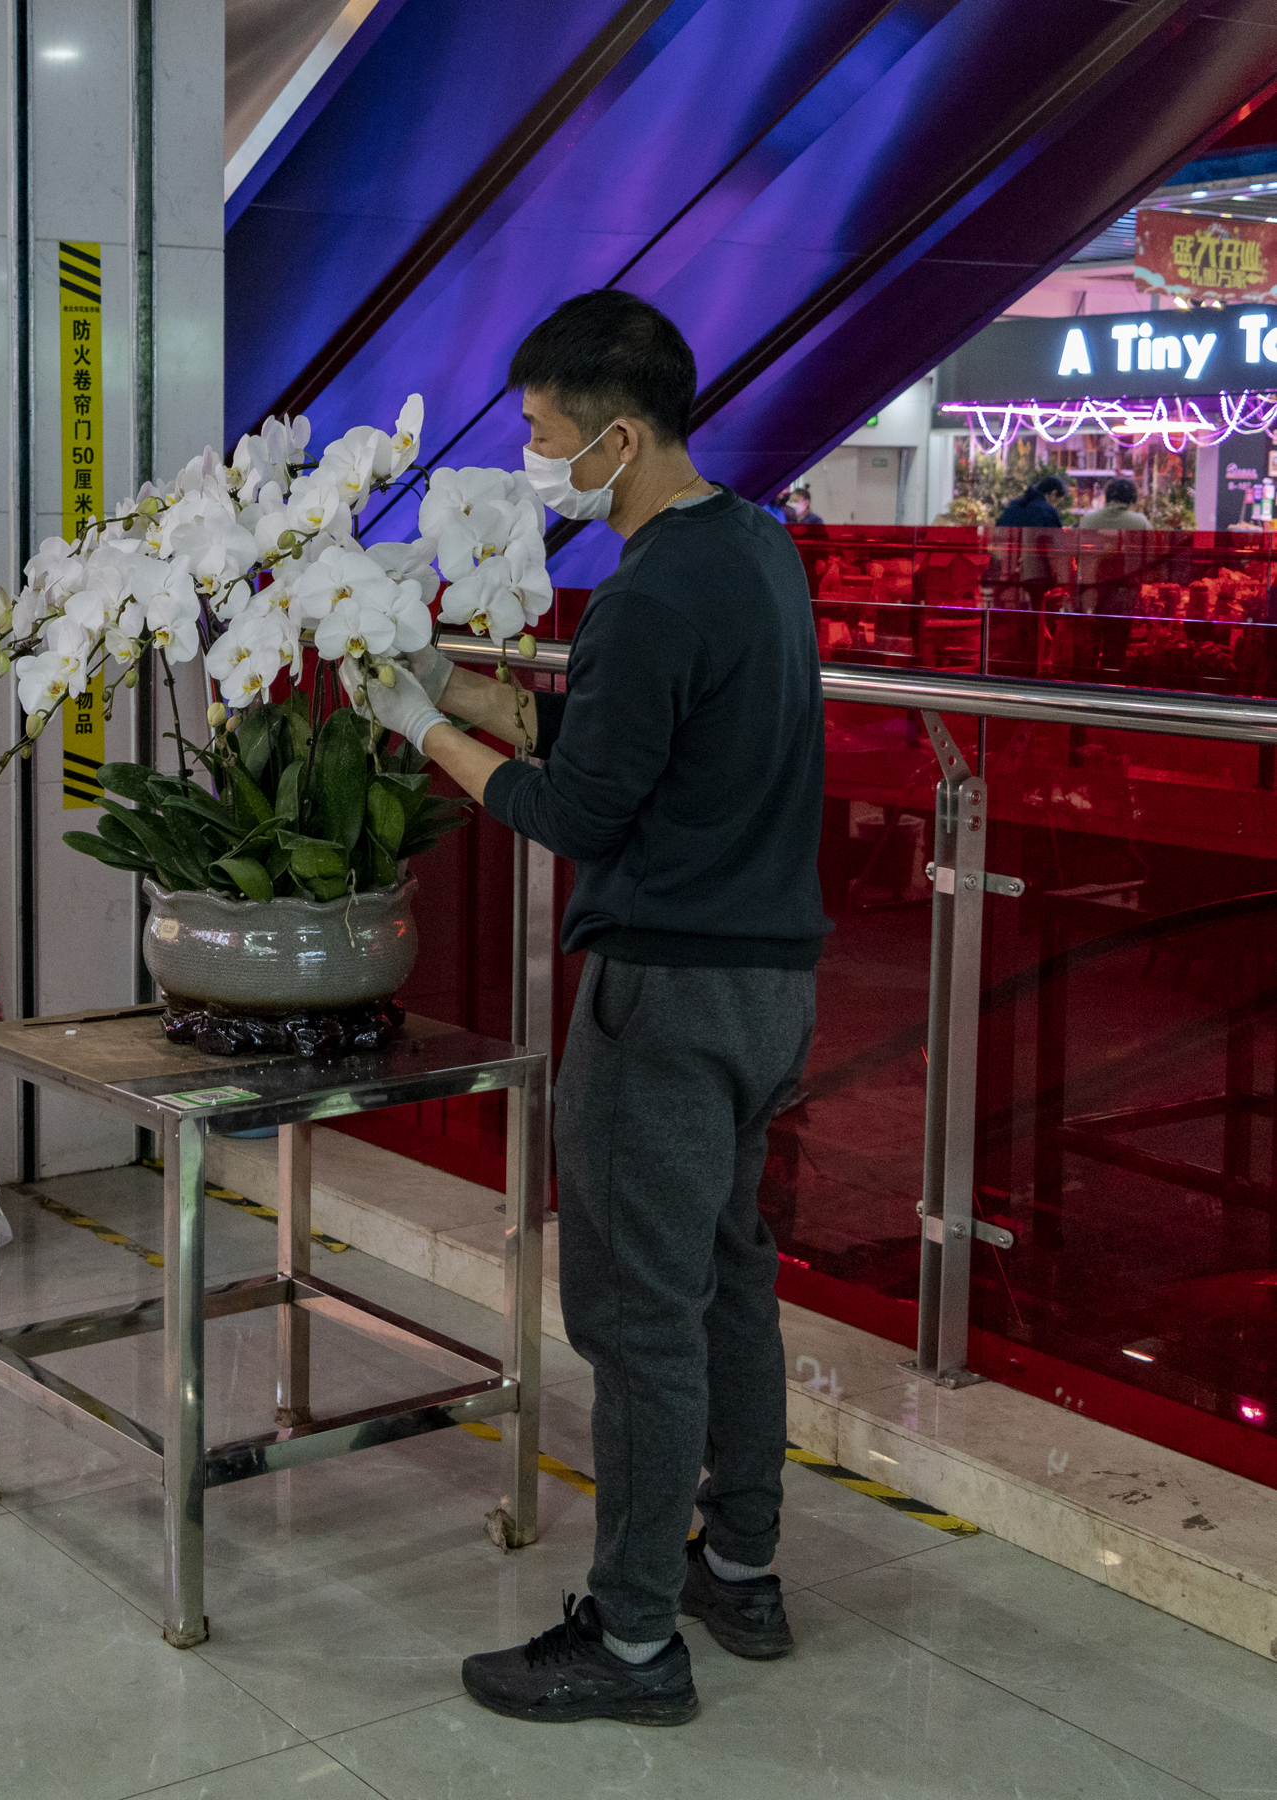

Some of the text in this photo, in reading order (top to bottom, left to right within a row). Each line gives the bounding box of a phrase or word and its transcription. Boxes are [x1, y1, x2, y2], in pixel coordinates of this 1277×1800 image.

[1170, 229, 1264, 272] 盛大开业
[1057, 328, 1092, 376] A
[1111, 322, 1218, 380] Tiny
